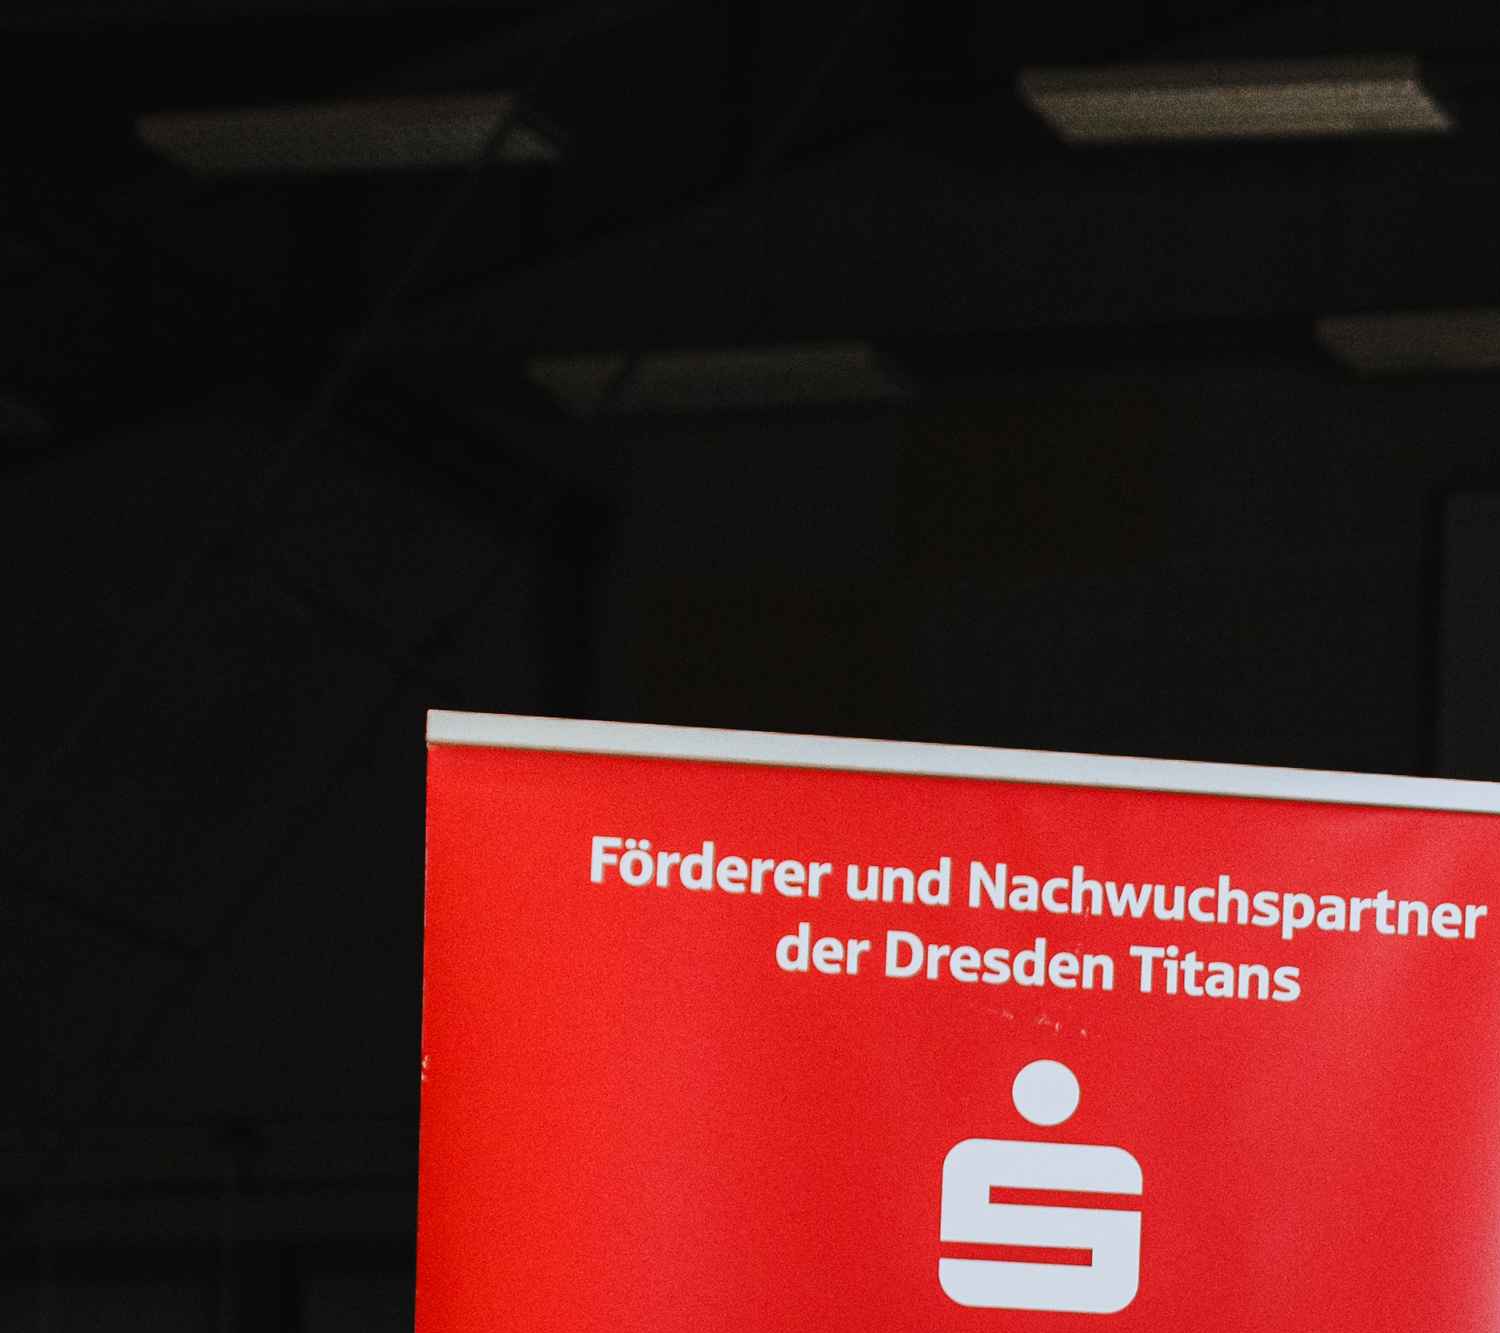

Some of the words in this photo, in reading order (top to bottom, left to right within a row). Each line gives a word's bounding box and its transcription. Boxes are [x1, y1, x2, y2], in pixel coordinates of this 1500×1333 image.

[589, 836, 831, 899] Förderer
[845, 858, 950, 906] und
[969, 861, 1488, 939] Nachwuchspartner
[775, 923, 869, 978] der
[885, 929, 1114, 991] Dresden
[1129, 943, 1302, 1003] Titans
